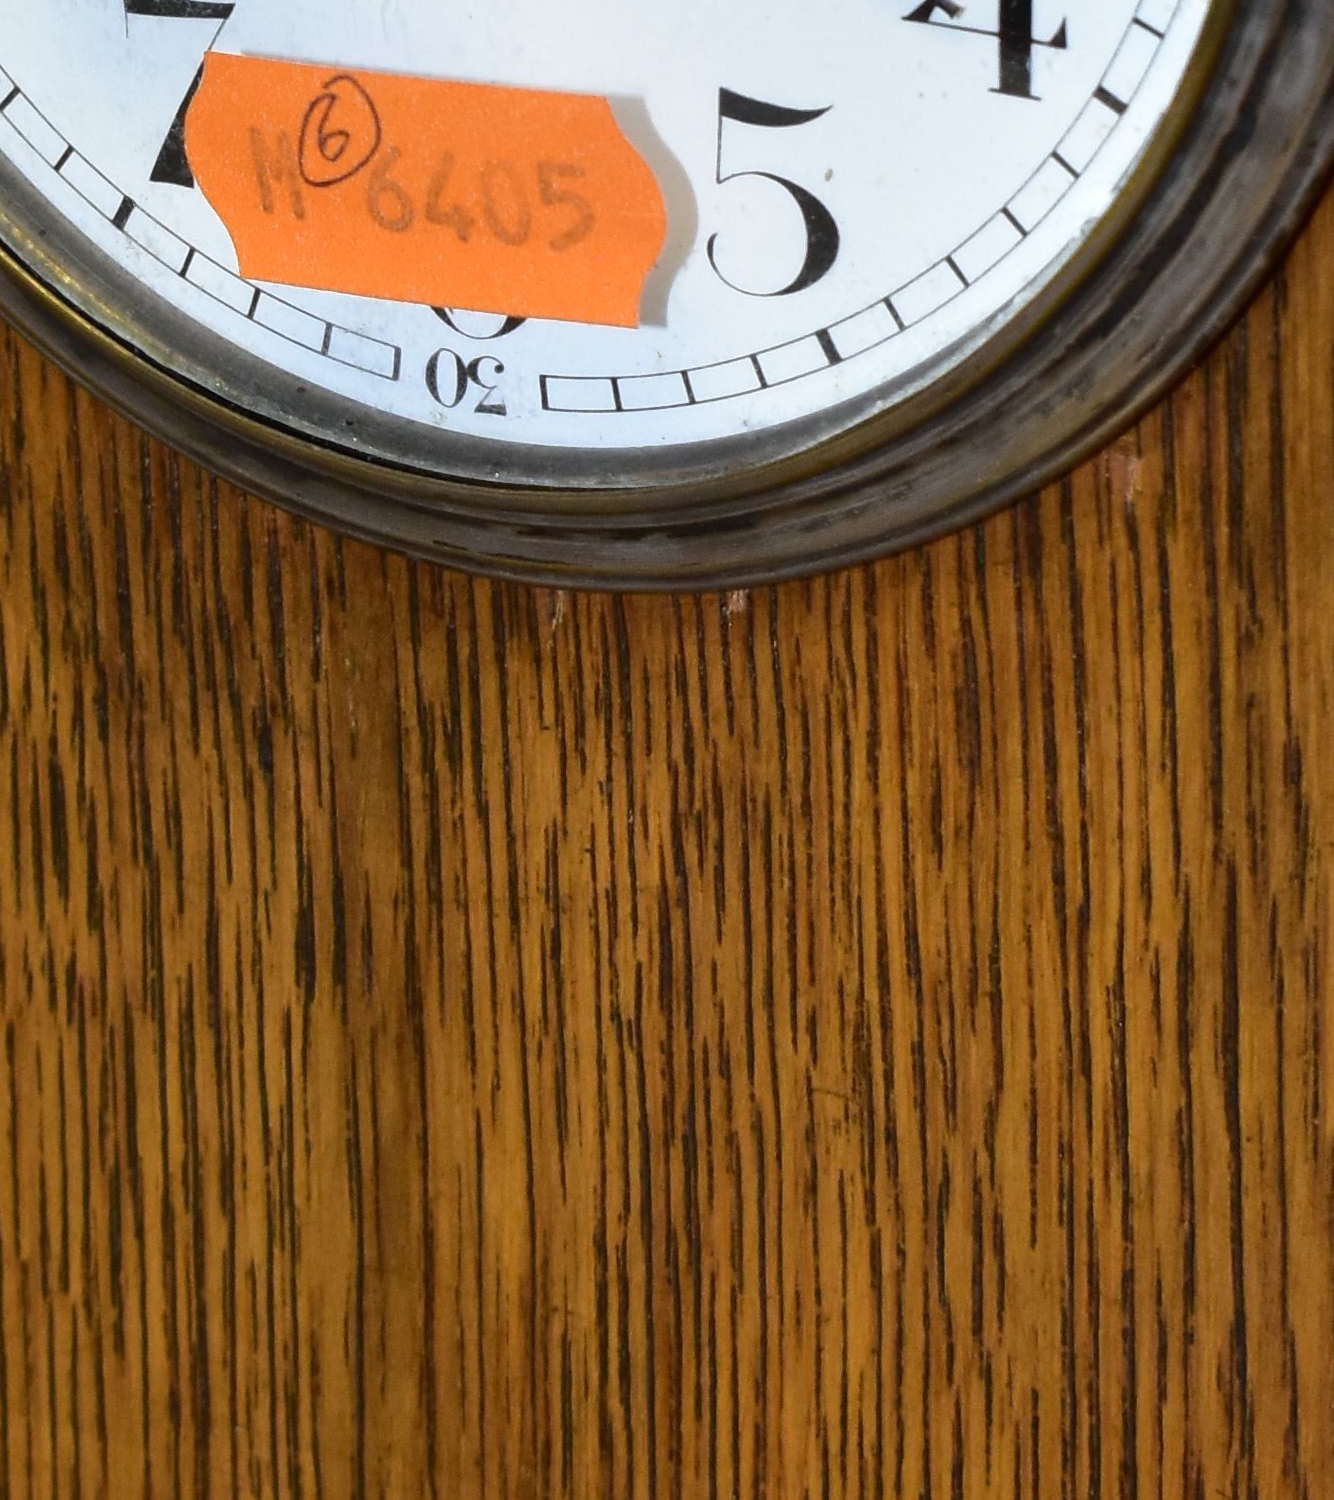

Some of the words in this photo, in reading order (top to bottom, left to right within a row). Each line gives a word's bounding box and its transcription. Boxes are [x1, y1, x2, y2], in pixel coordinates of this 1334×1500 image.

[366, 144, 598, 252] 6405
[706, 87, 841, 297] 5
[424, 347, 508, 417] 30
